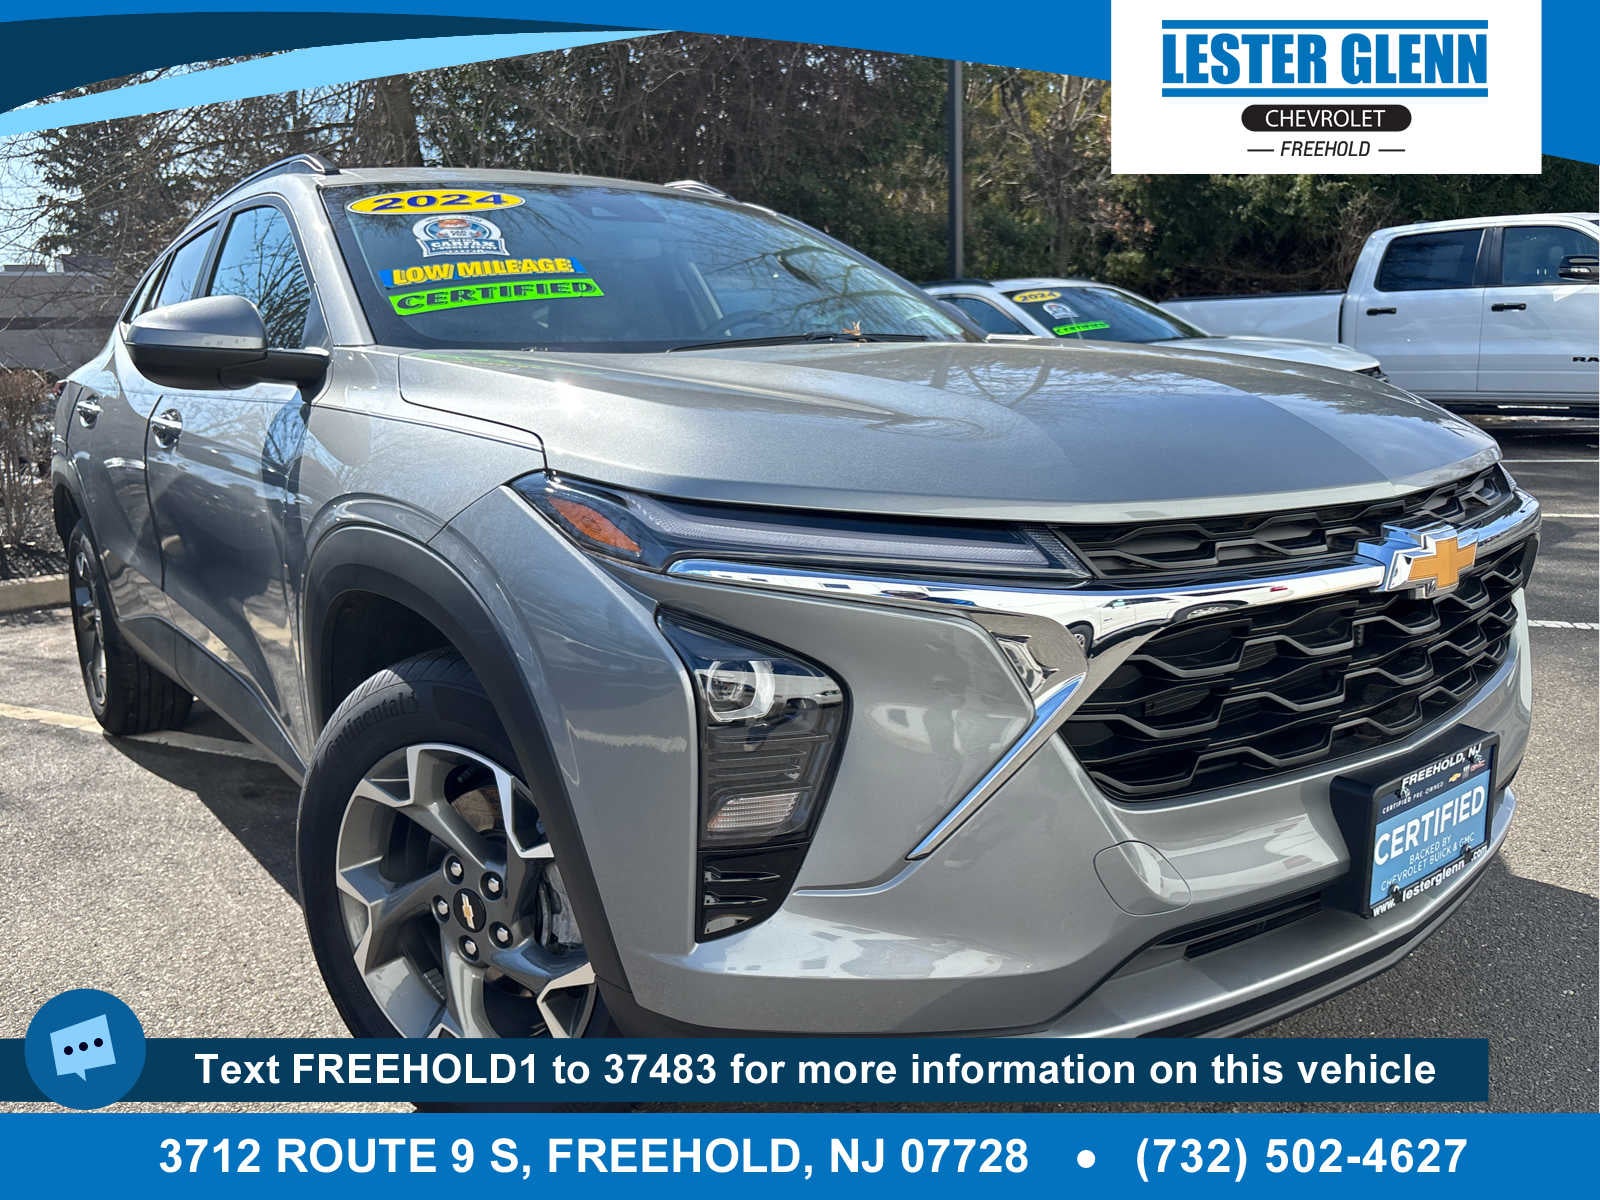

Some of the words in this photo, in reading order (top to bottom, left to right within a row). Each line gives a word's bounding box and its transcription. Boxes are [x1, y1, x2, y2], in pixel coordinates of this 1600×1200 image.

[371, 193, 508, 211] 2024
[392, 265, 453, 286] LOW
[456, 257, 575, 278] MILEAGE
[397, 281, 598, 310] CERTIFIED
[1401, 752, 1466, 788] FREEHOLD,
[1467, 743, 1482, 758] NJ
[1382, 795, 1412, 815] CERTIFIED
[1374, 785, 1485, 866] CERTIFIED
[1381, 858, 1429, 891] CHEVROLET
[1429, 846, 1452, 865] BUICK
[1459, 832, 1475, 848] GMC
[1409, 841, 1440, 865] BACKED
[1441, 835, 1451, 849] BY
